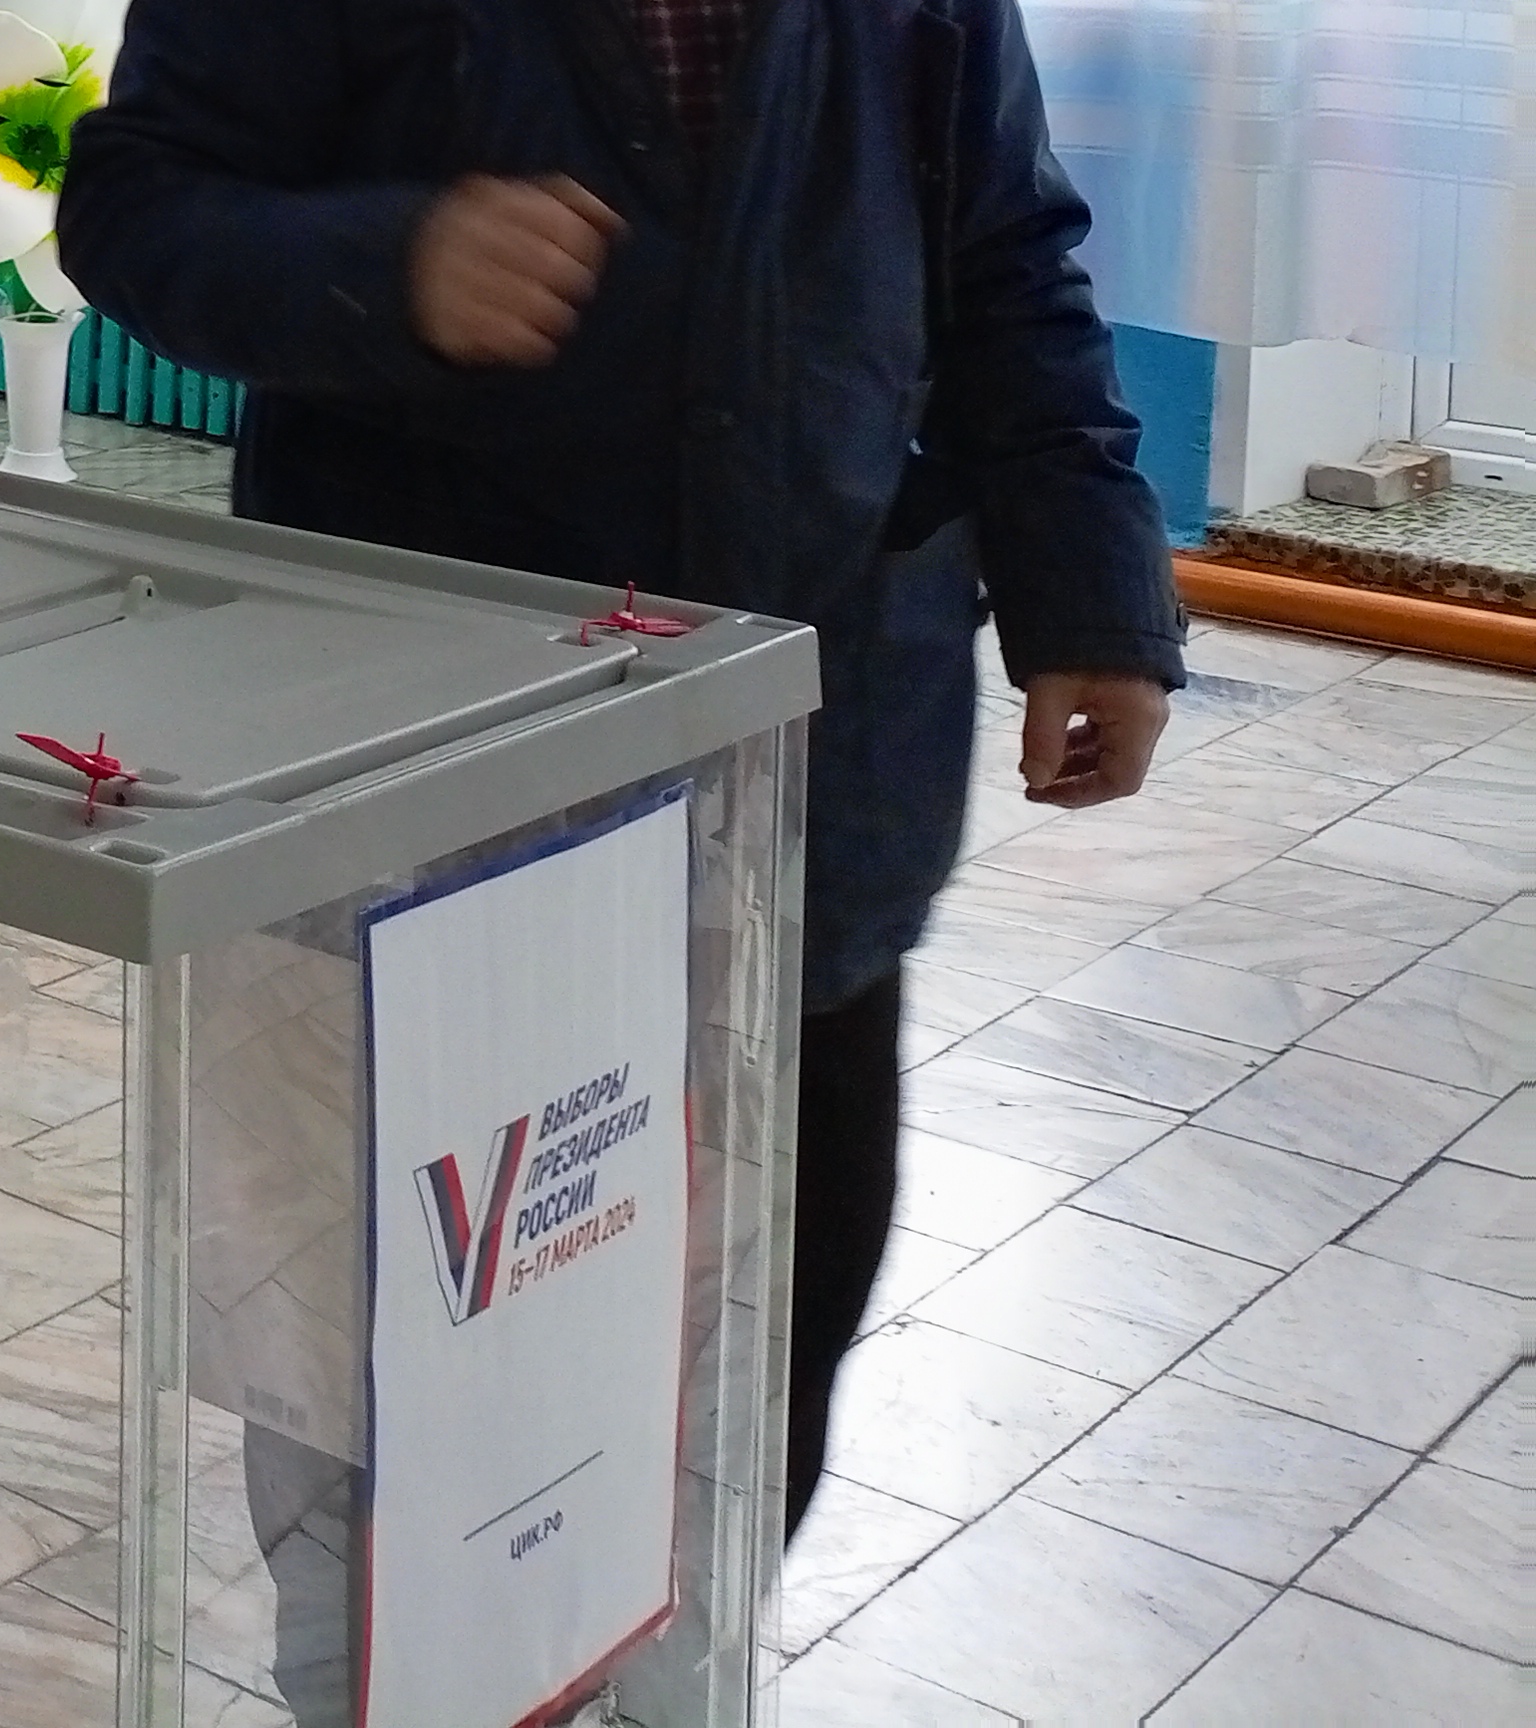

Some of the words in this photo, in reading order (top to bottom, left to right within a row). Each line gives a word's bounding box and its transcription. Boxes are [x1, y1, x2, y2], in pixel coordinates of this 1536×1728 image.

[538, 1062, 629, 1141] ВЫБОРЫ
[523, 1094, 650, 1194] ПРЕЗИДЕНТА
[514, 1170, 596, 1249] РОССИИ
[549, 1214, 599, 1272] МАРТА
[510, 1508, 564, 1562] ЦИК.РФ
